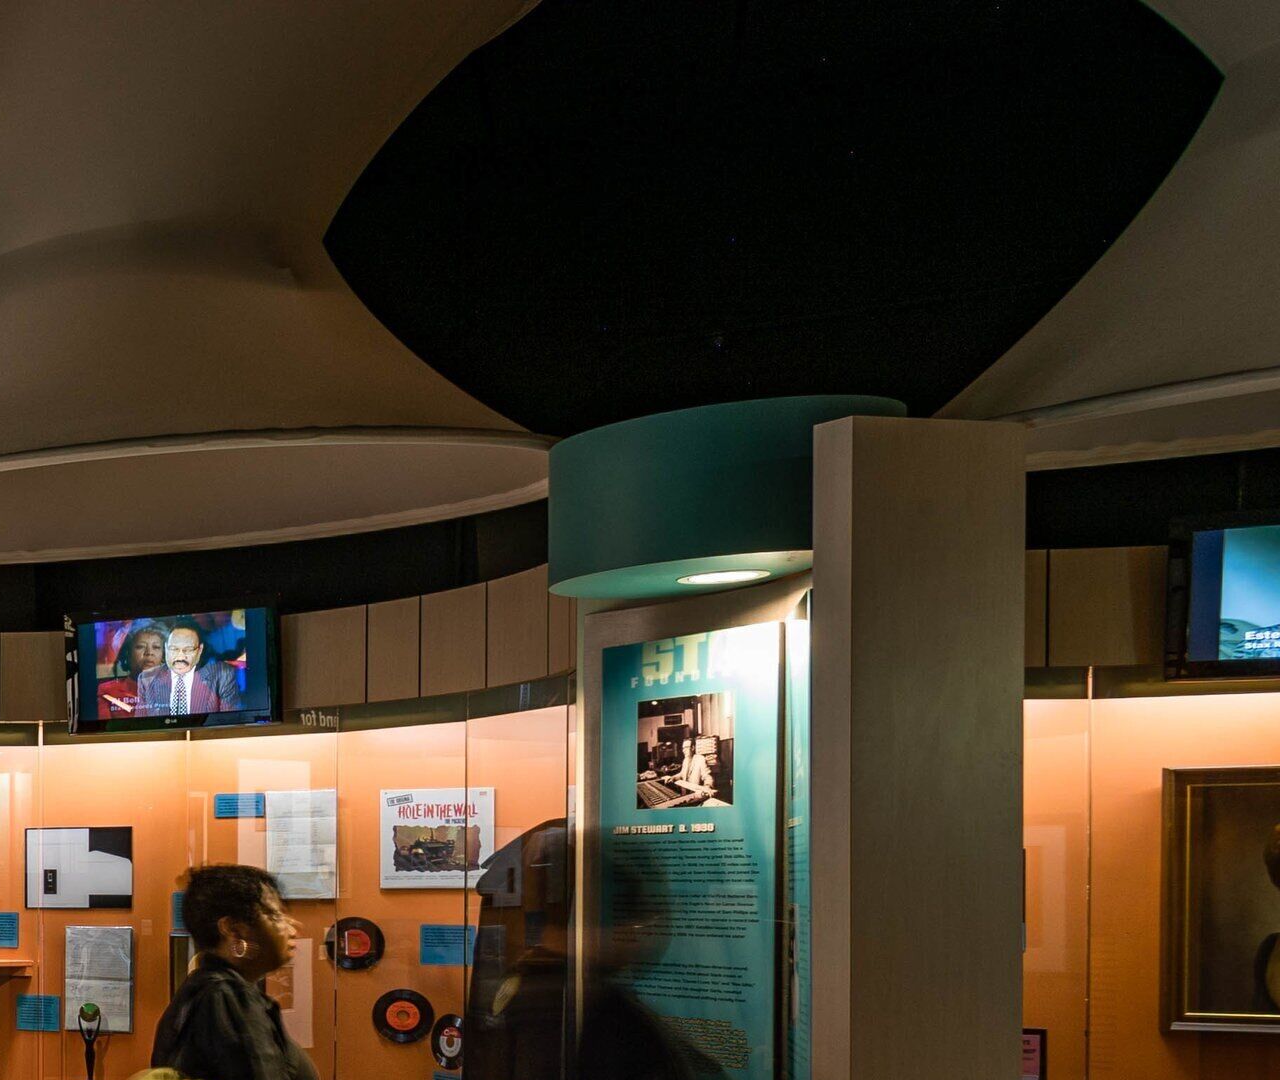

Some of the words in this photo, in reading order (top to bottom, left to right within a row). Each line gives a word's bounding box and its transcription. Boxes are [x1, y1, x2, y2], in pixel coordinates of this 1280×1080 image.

[398, 804, 422, 819] HOLE
[436, 804, 453, 820] THE
[453, 802, 478, 818] WALL
[613, 825, 629, 835] JIM
[630, 824, 675, 835] STEWART
[690, 822, 716, 833] 1930
